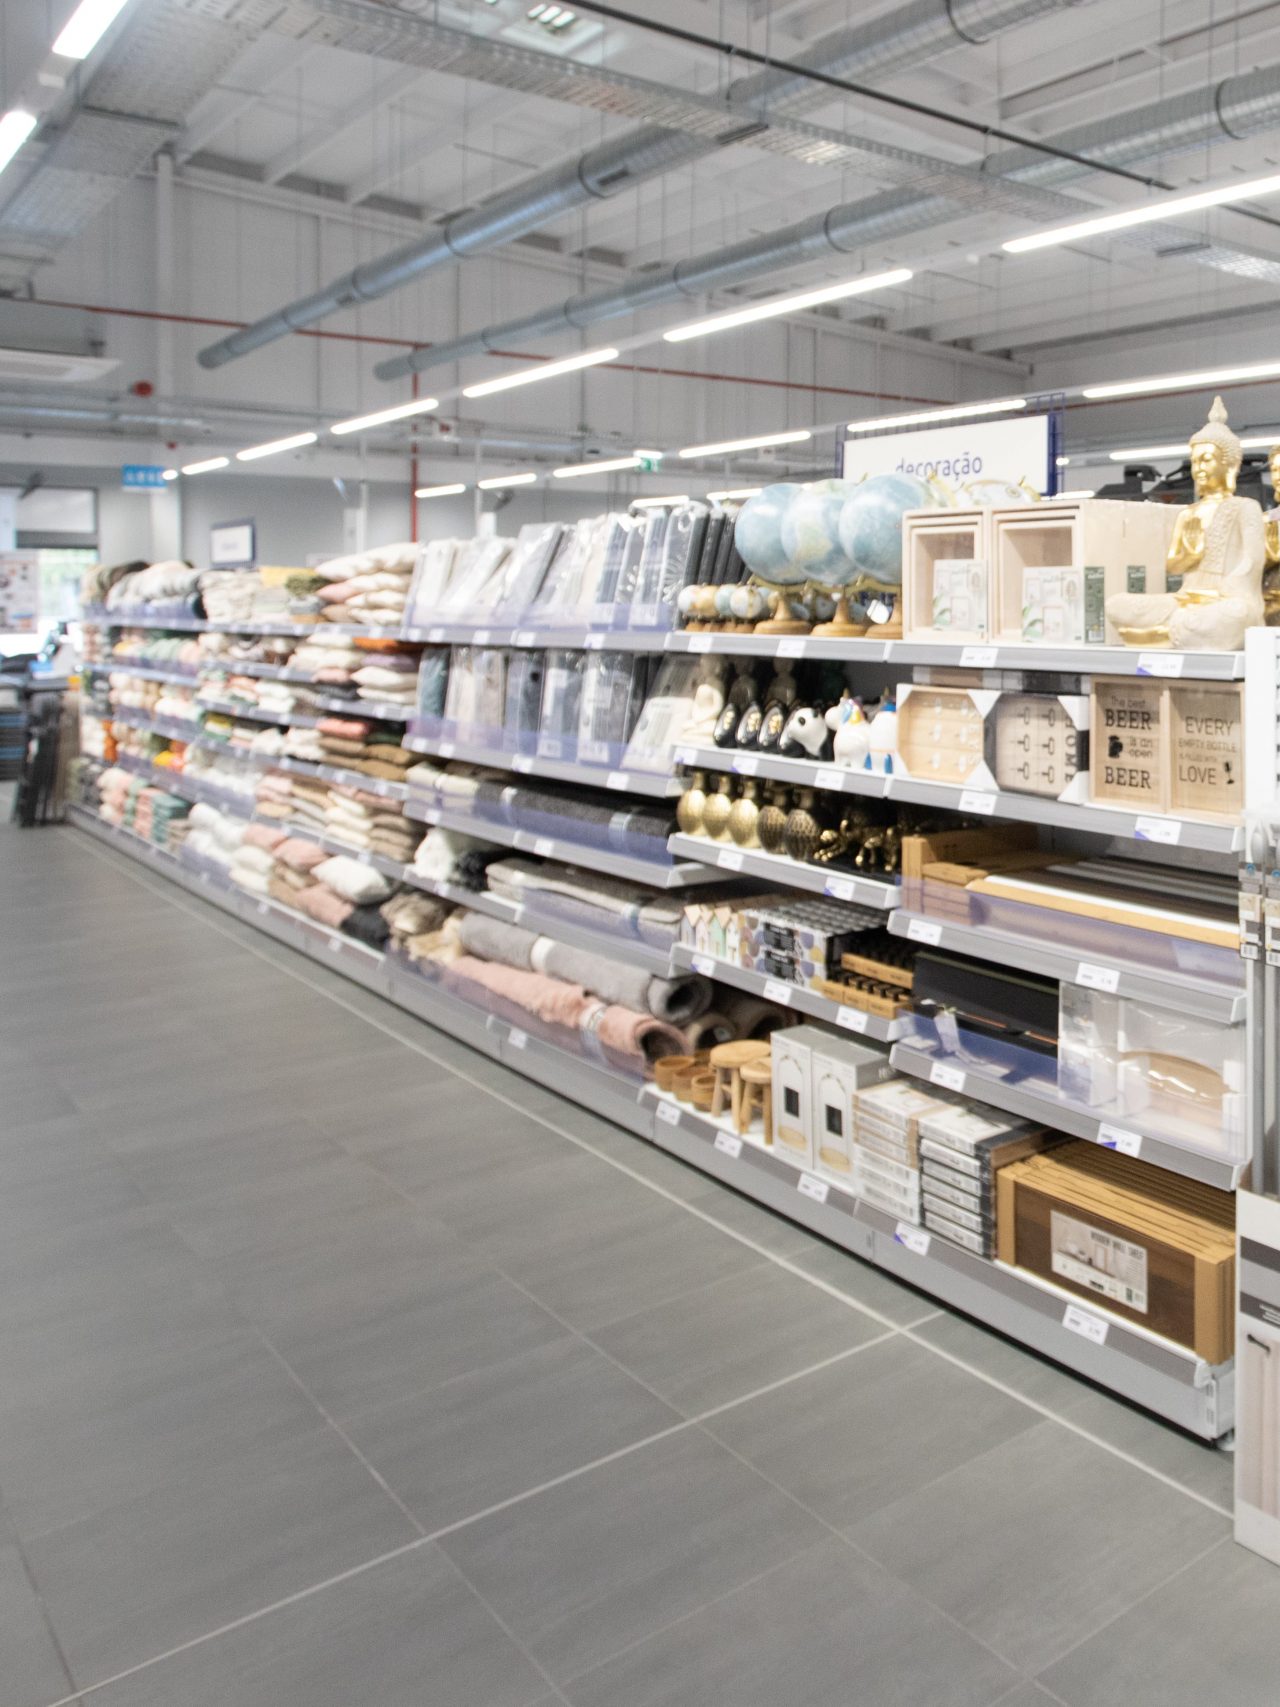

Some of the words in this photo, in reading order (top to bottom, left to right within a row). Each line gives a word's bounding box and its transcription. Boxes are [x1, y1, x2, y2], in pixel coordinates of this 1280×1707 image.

[1104, 708, 1152, 730] BEER
[1185, 716, 1234, 736] EVERY
[1128, 750, 1153, 758] open
[1104, 766, 1152, 789] BEER
[1178, 765, 1216, 785] LOVE
